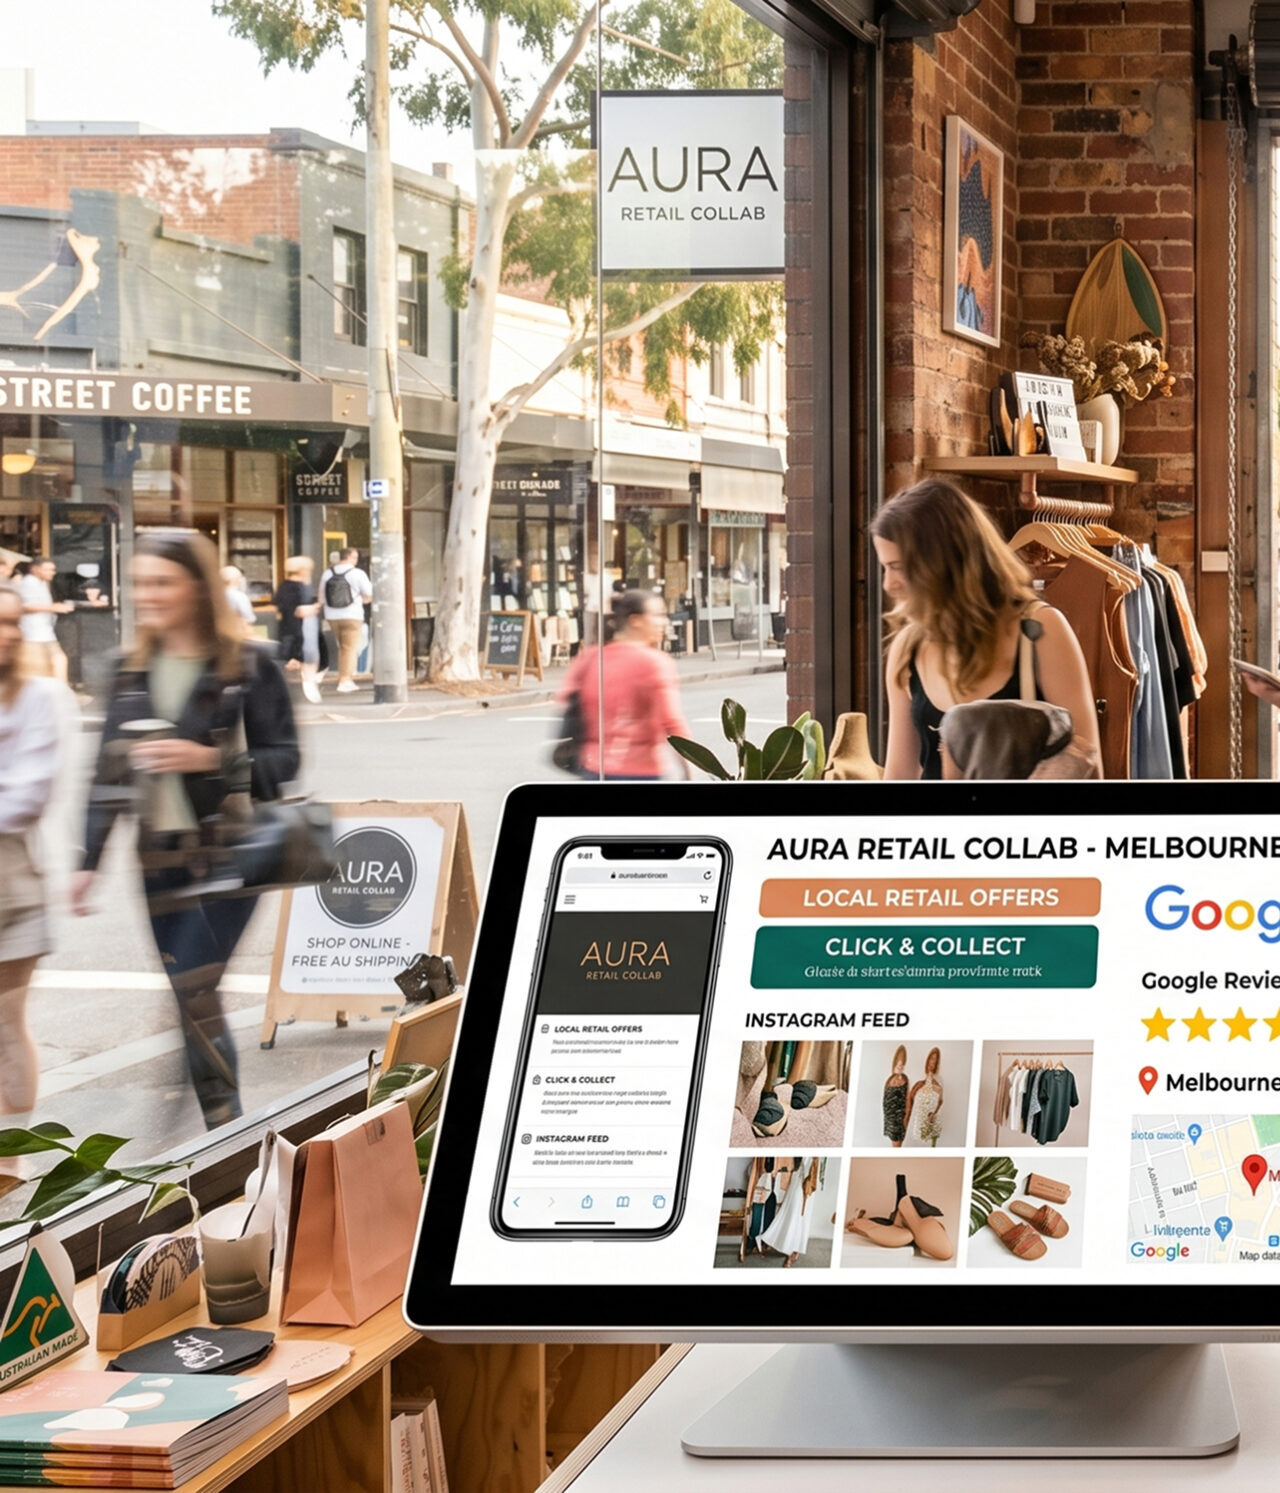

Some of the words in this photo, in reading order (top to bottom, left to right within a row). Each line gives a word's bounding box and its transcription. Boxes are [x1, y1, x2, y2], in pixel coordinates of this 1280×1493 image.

[608, 146, 778, 192] AURA
[622, 207, 684, 220] RETAIL
[691, 207, 765, 220] COLLAB
[132, 381, 252, 415] COFFEE
[767, 838, 848, 860] AURA
[858, 838, 955, 859] RETAIL
[964, 837, 1077, 859] COLLAB
[332, 886, 360, 895] RETAIL
[362, 886, 395, 895] COLLAB
[804, 889, 878, 906] LOCAL
[886, 889, 963, 906] RETAIL
[970, 888, 1058, 906] OFFERS
[307, 937, 346, 948] SHOP
[350, 938, 401, 948] ONLINE
[826, 938, 893, 955] CLICK
[899, 938, 914, 955] &
[922, 938, 1025, 955] COLLECT
[581, 942, 669, 966] AURA
[292, 956, 327, 966] FREE
[331, 956, 351, 967] AU
[586, 971, 618, 980] RETAIL
[623, 971, 661, 980] COLLAB
[1142, 971, 1217, 993] Google
[746, 1013, 855, 1027] INSTAGRAM
[862, 1013, 909, 1027] FEED
[554, 1025, 581, 1034] LOCAL
[582, 1025, 610, 1034] RETAIL
[611, 1025, 643, 1034] OFFERS
[545, 1076, 570, 1085] CLICK
[578, 1075, 615, 1085] COLLECT
[536, 1134, 586, 1144] INSTAGRAM
[586, 1134, 609, 1143] FEED
[1130, 1242, 1190, 1262] Google
[1239, 1251, 1259, 1263] Map
